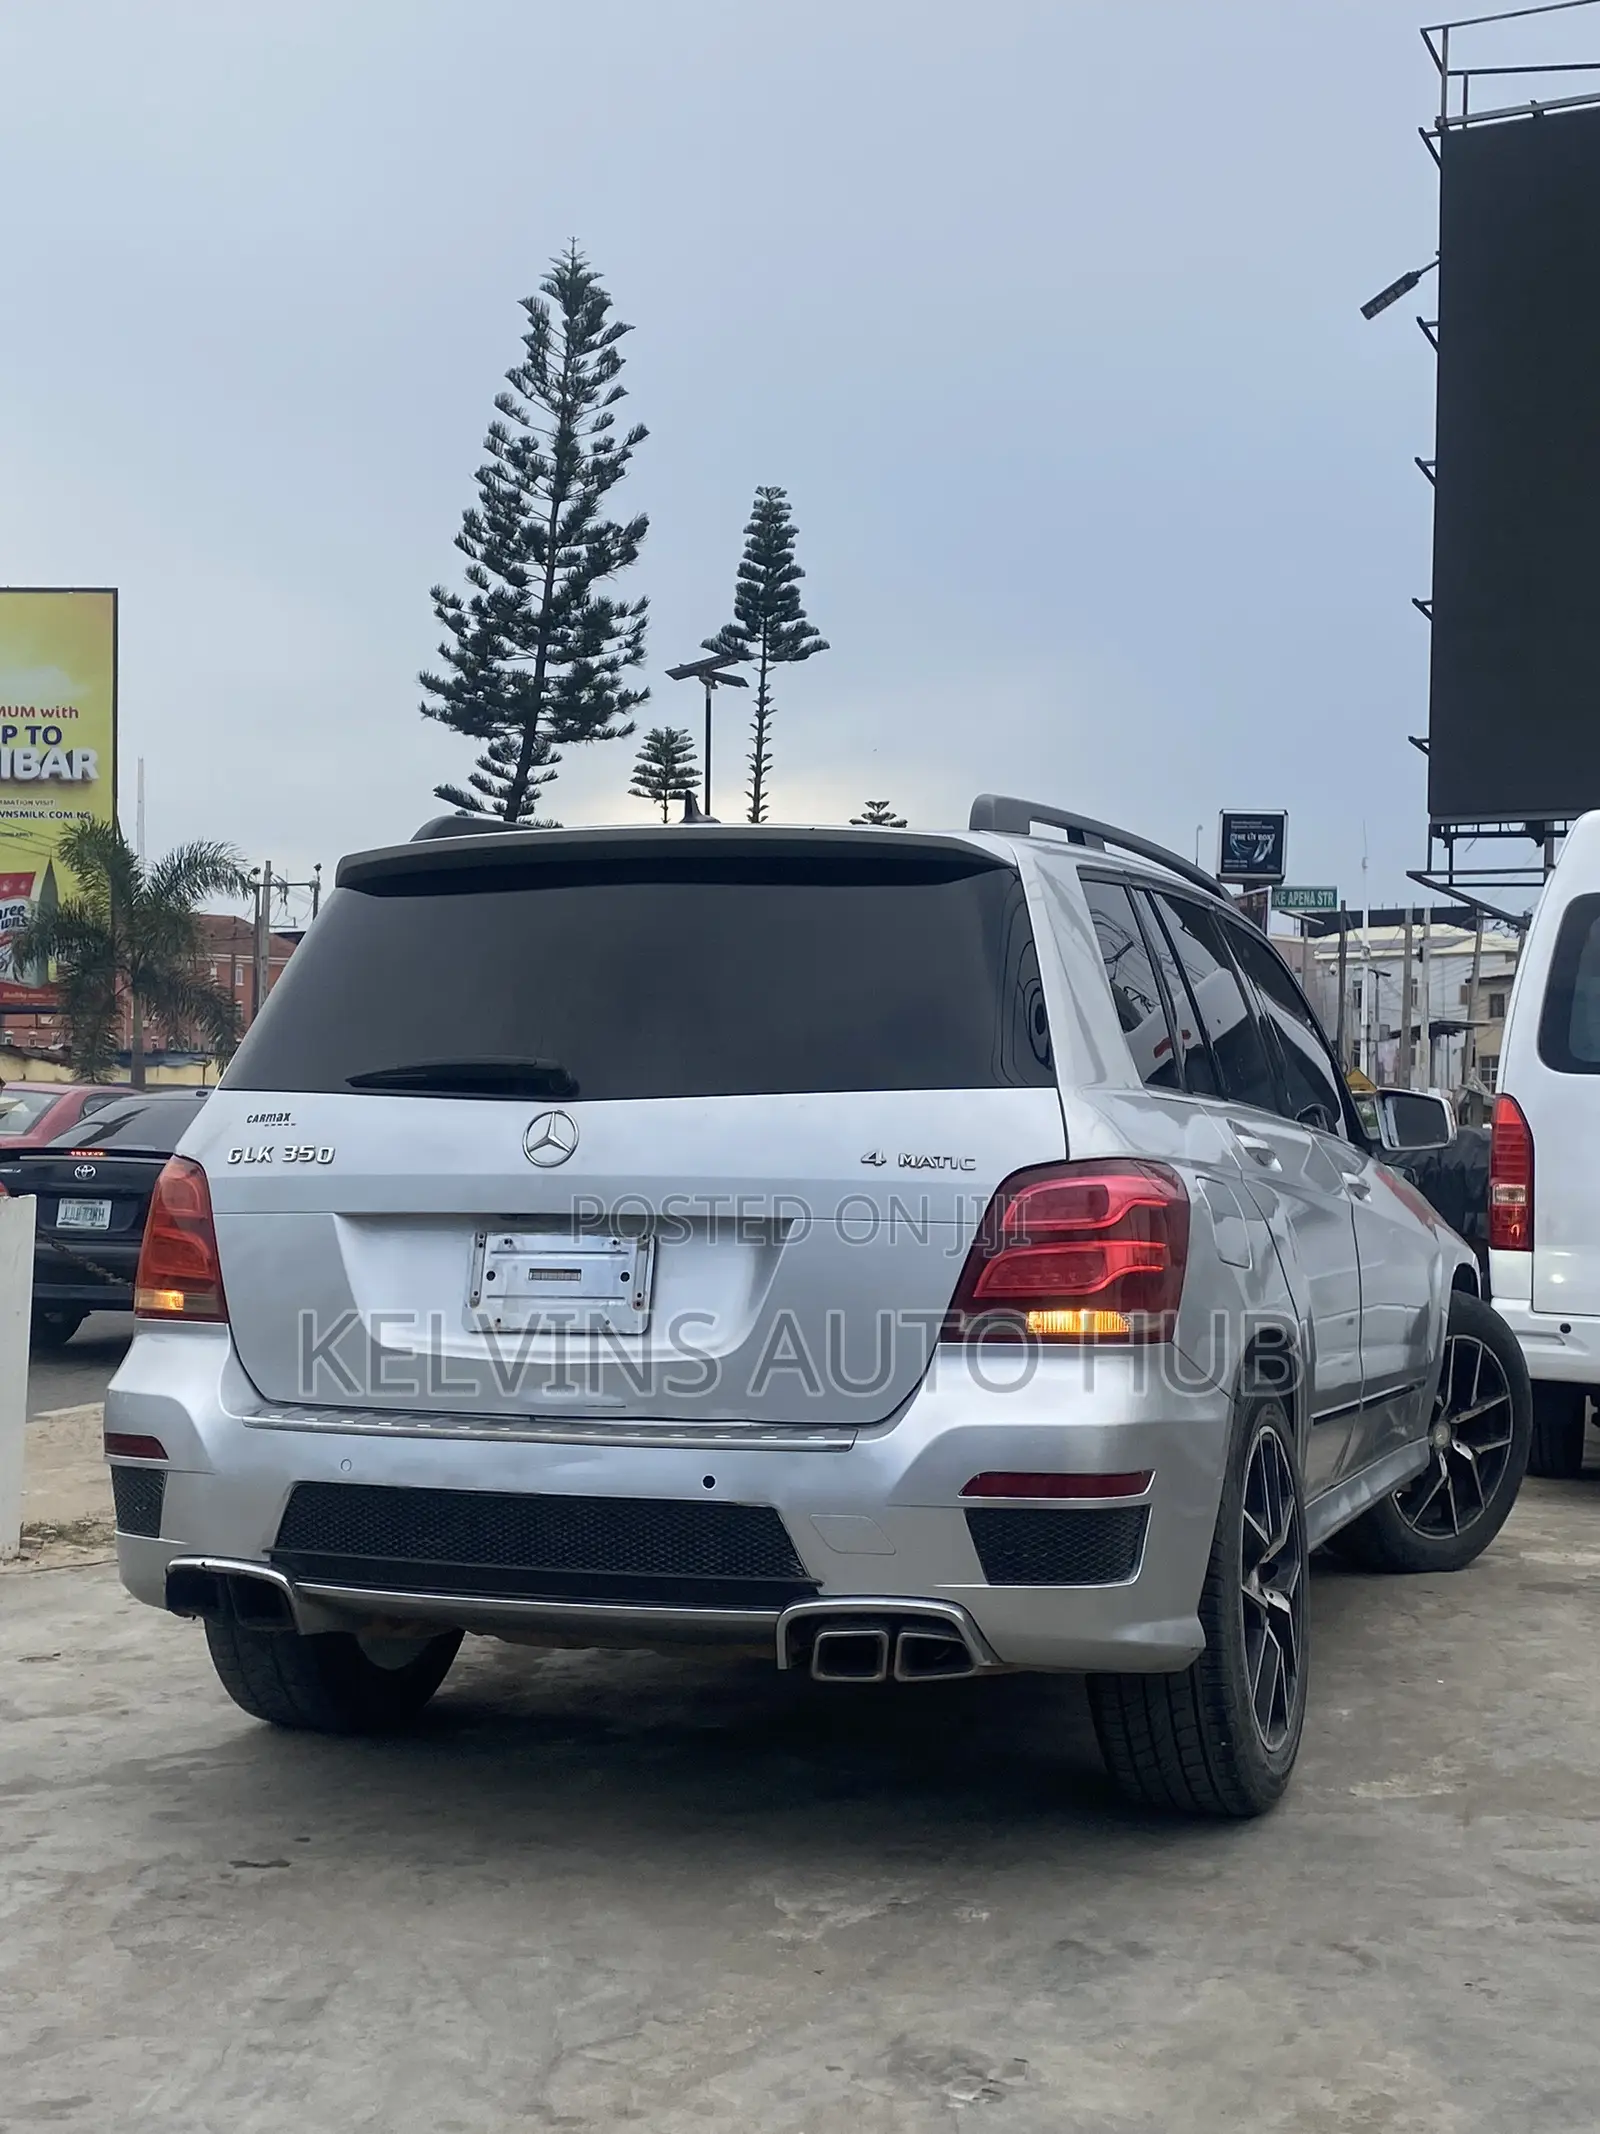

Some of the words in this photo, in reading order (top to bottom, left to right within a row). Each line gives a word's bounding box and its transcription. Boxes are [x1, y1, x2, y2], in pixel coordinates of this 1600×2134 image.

[40, 706, 79, 718] with
[25, 726, 62, 745] TO
[1288, 891, 1316, 906] APENA
[1317, 891, 1334, 906] STR
[227, 1146, 275, 1164] GLK
[282, 1145, 335, 1164] 350
[861, 1149, 887, 1166] 4
[898, 1153, 977, 1171] MATIC
